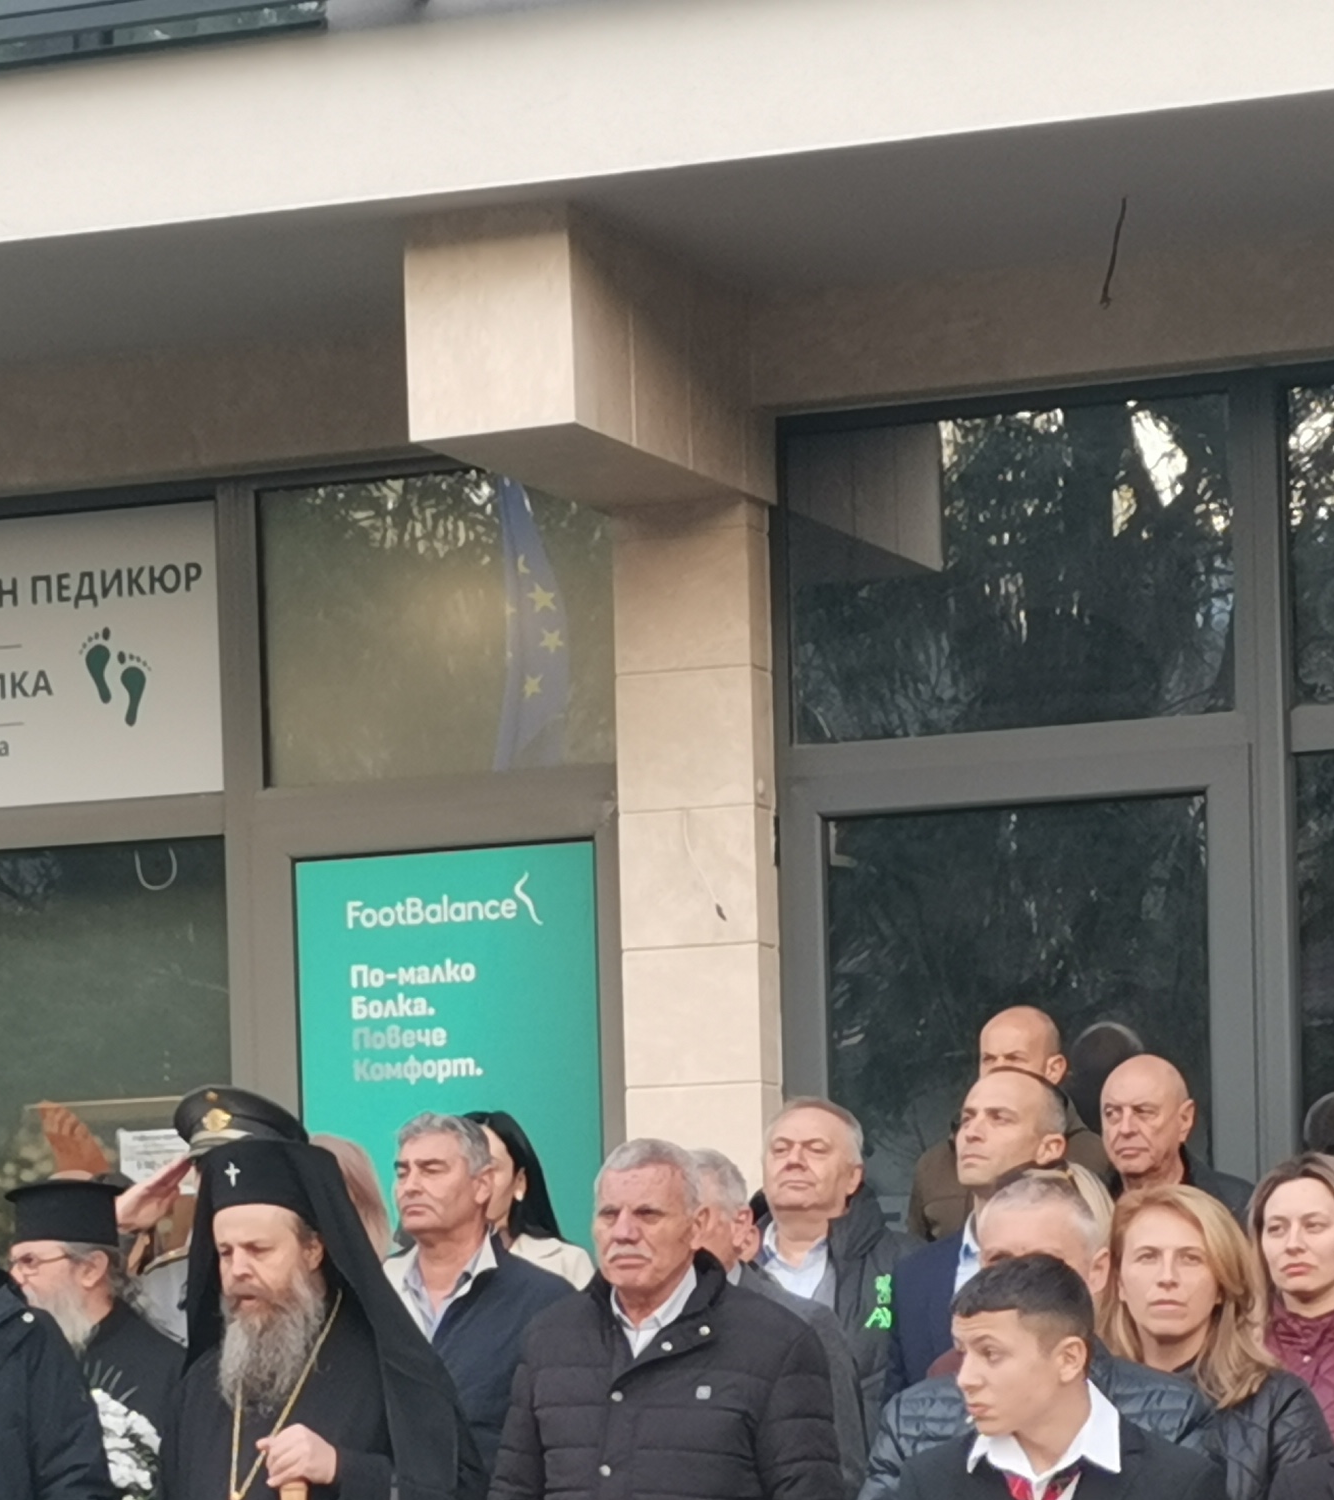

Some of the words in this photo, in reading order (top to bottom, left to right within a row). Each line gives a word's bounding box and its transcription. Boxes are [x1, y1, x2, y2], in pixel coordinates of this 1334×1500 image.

[30, 562, 203, 610] ПЕДИКЮР
[346, 893, 519, 930] FootBalance
[350, 957, 477, 989] По-малко
[351, 992, 437, 1021] Болка.
[352, 1024, 448, 1051] Повече
[353, 1054, 484, 1086] Комфорт.
